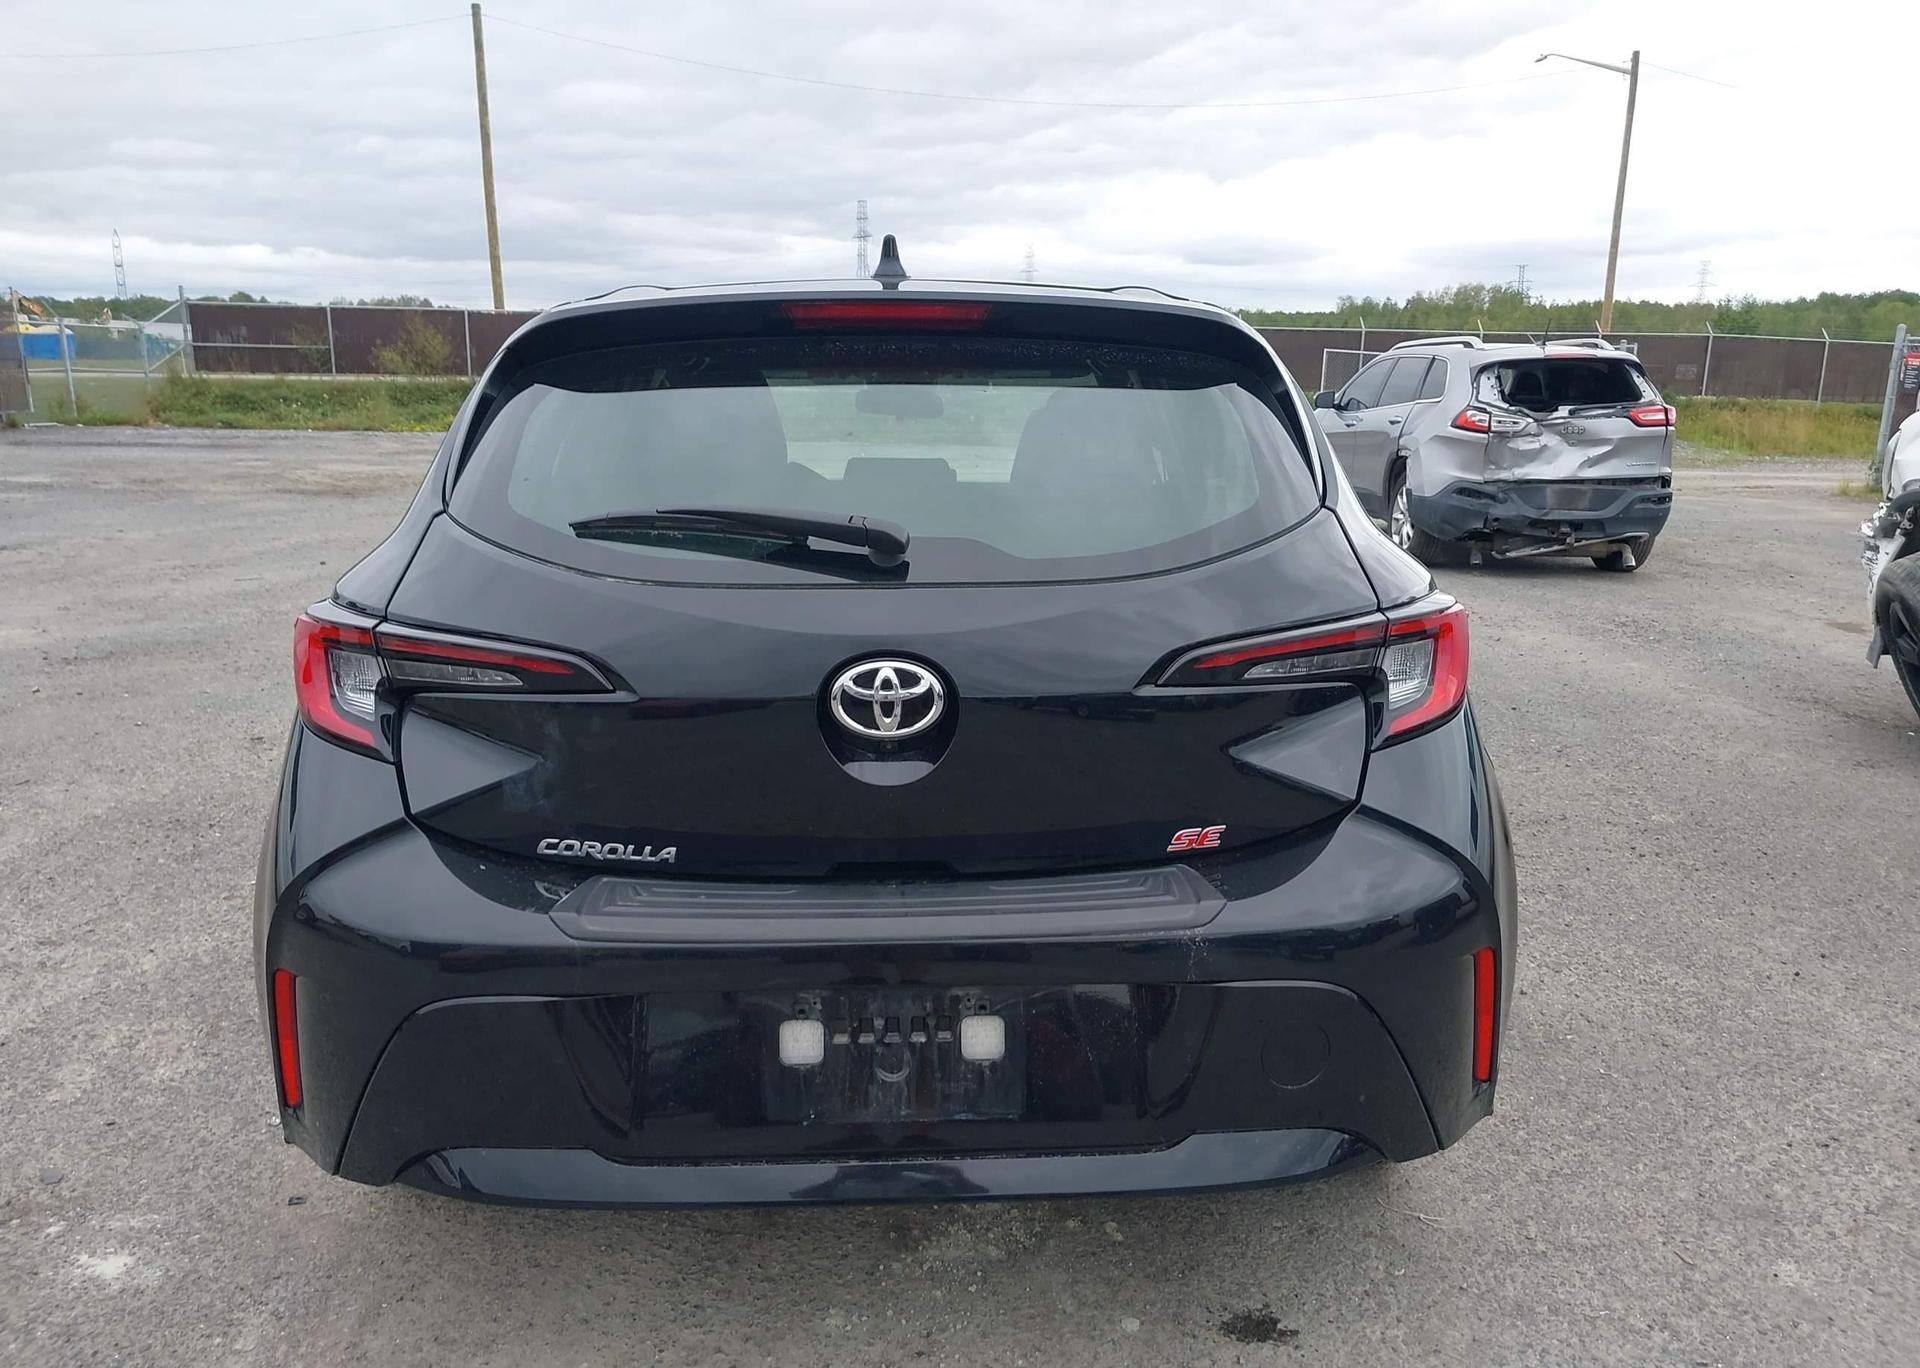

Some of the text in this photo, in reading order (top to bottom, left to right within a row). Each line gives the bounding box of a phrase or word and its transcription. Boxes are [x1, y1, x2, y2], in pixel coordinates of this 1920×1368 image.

[1561, 425, 1585, 434] Jeep
[537, 838, 677, 863] COROLLA
[1167, 825, 1226, 852] SE
